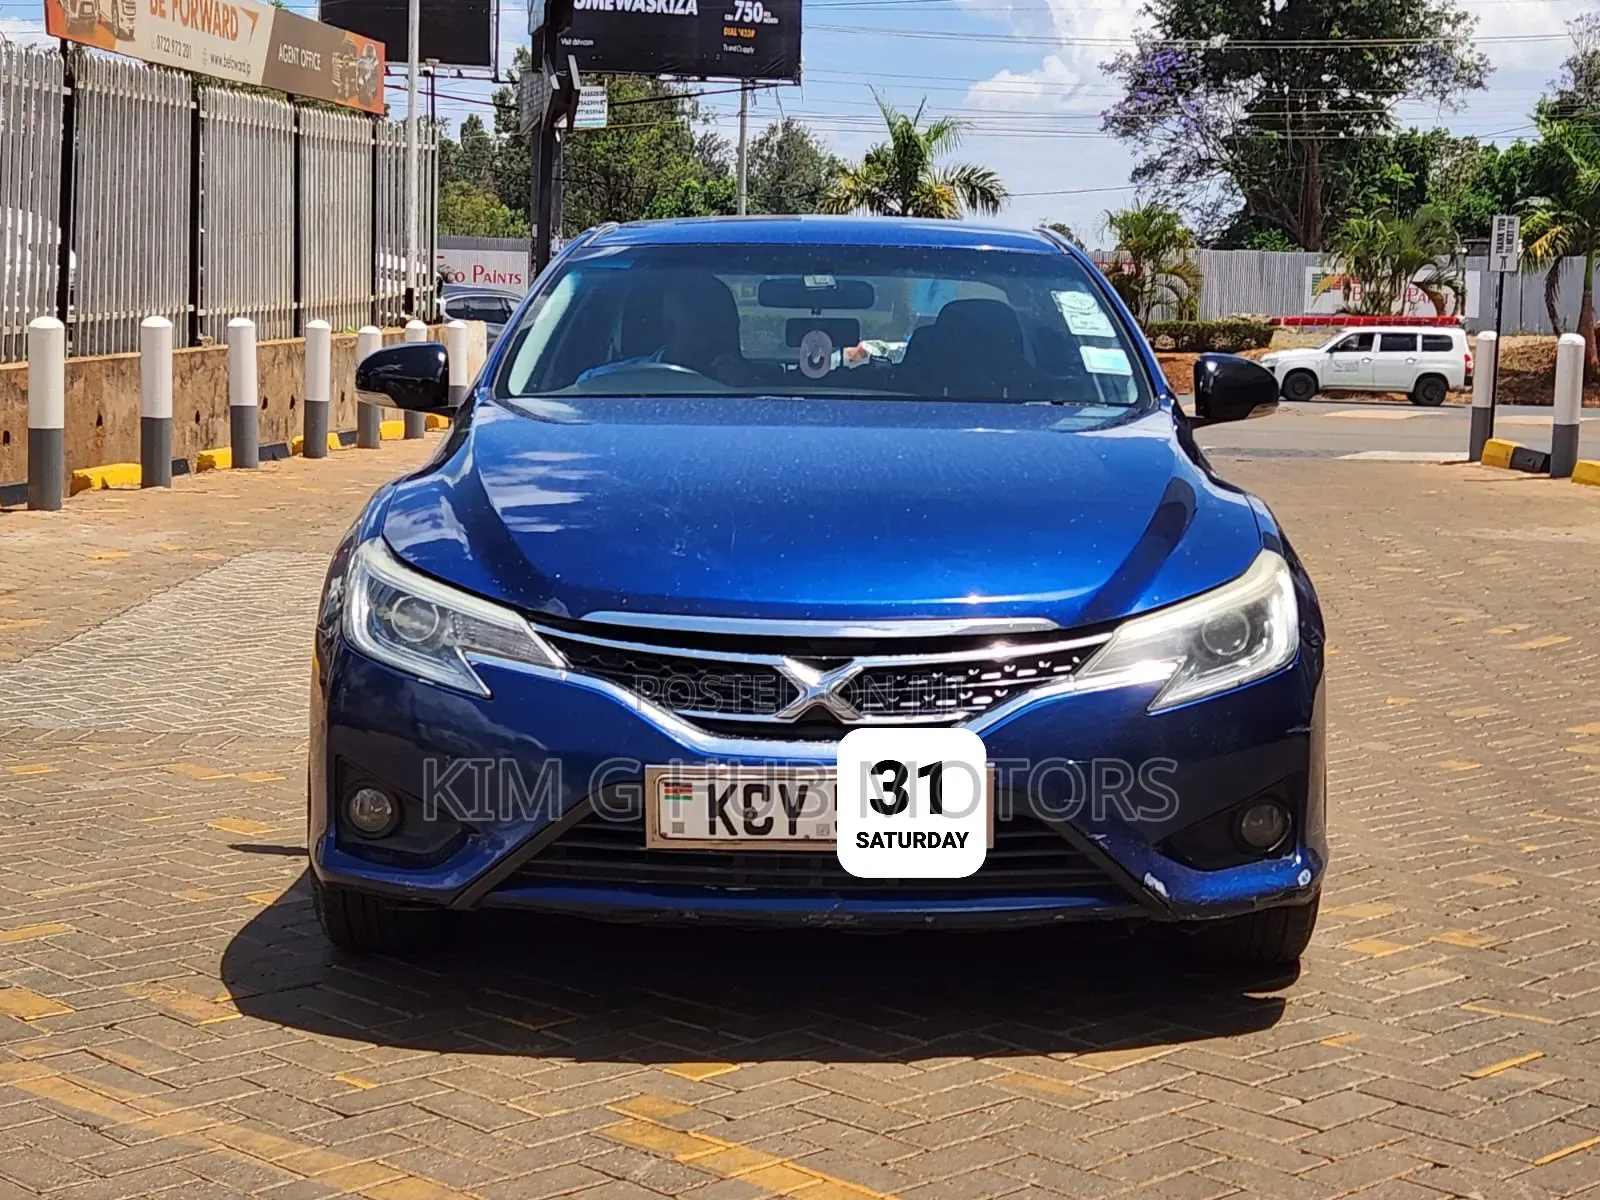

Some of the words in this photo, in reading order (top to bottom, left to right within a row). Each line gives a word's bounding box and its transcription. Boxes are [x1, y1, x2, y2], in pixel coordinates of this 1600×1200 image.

[171, 0, 239, 41] FORWARD
[734, 0, 763, 23] 750
[723, 27, 738, 36] DIAL
[279, 43, 299, 65] AGENT
[300, 48, 321, 71] OFFICE
[708, 783, 809, 836] KCY
